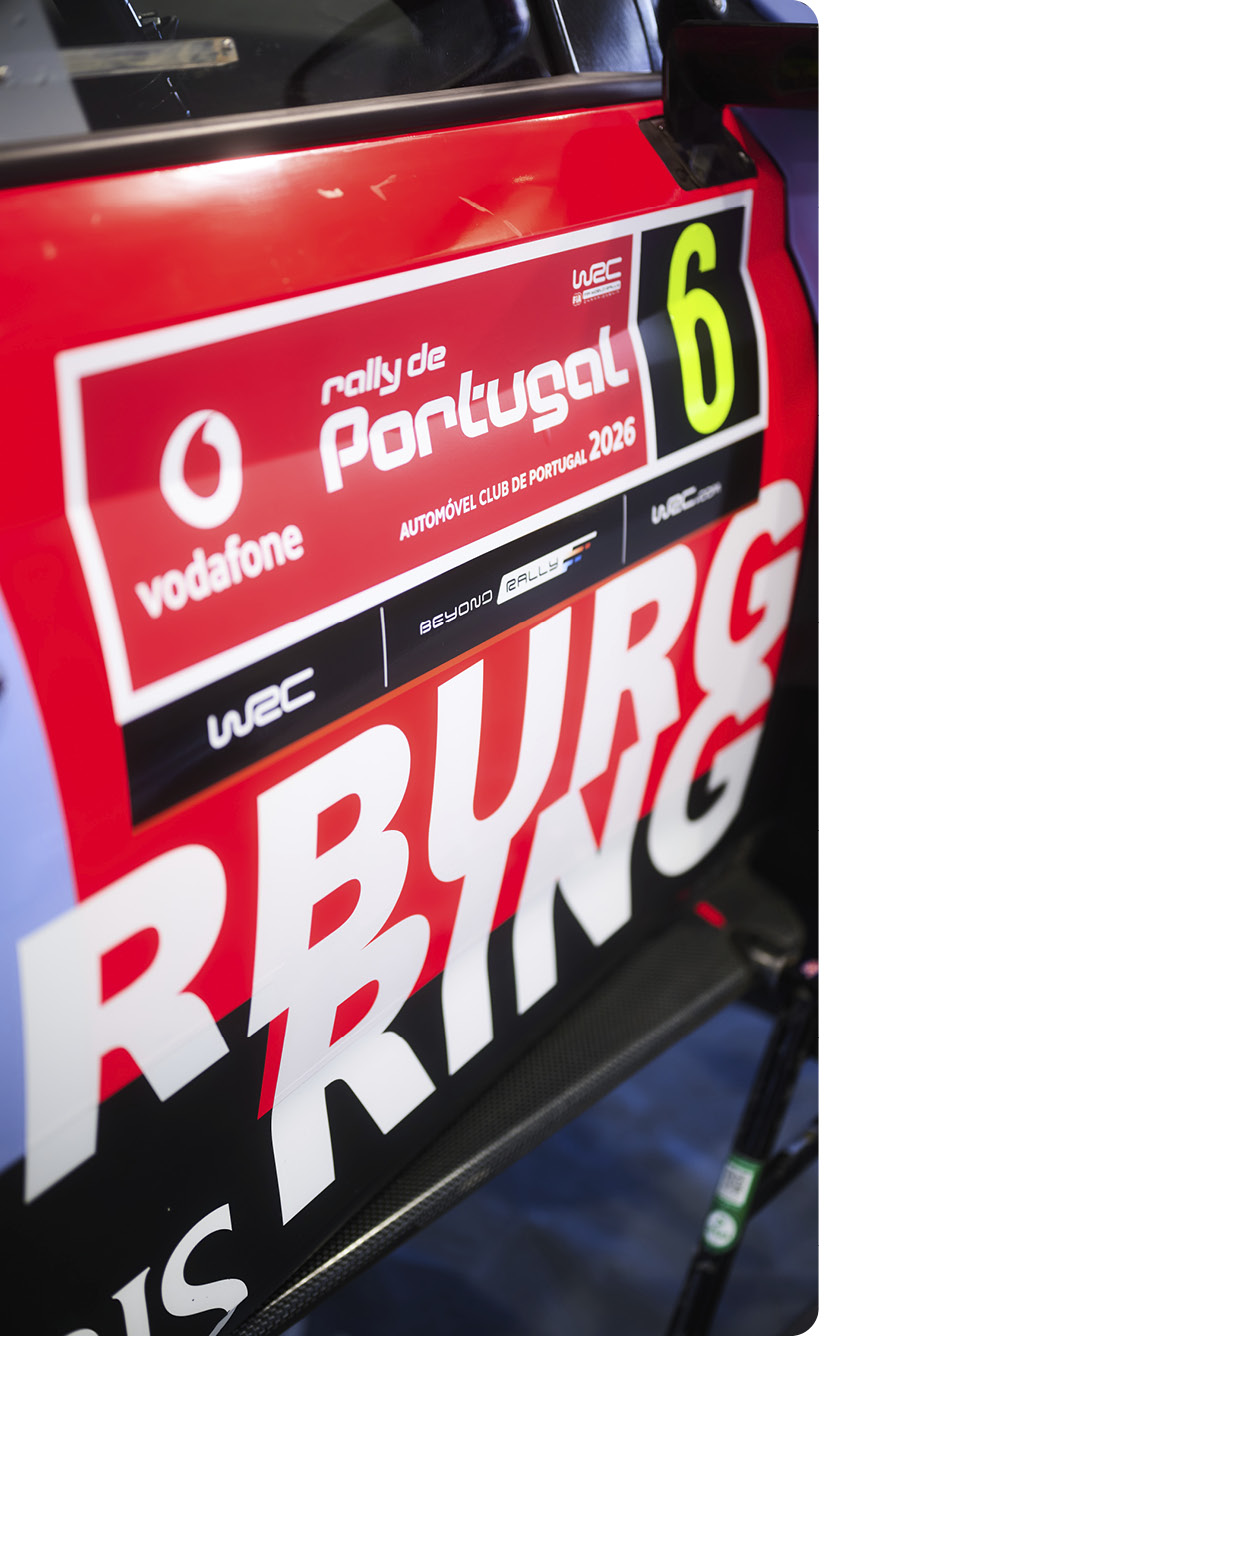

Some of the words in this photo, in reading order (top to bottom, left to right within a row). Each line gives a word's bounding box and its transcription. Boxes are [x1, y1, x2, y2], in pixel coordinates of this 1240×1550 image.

[572, 256, 622, 290] WRC
[321, 355, 402, 406] rally
[407, 342, 447, 378] de
[667, 222, 735, 435] 6
[319, 325, 630, 494] Portugal
[399, 494, 477, 541] AUTOMÓVEL
[478, 480, 510, 507] CLUB
[511, 473, 527, 493] DE
[529, 449, 588, 486] PORTUGAL
[588, 416, 637, 462] 2026
[135, 524, 304, 619] vodafone
[419, 589, 493, 636] BEYOND
[506, 556, 559, 593] RALLY
[206, 666, 316, 750] WRC
[271, 658, 773, 1226] RING
[64, 1203, 249, 1336] IS
